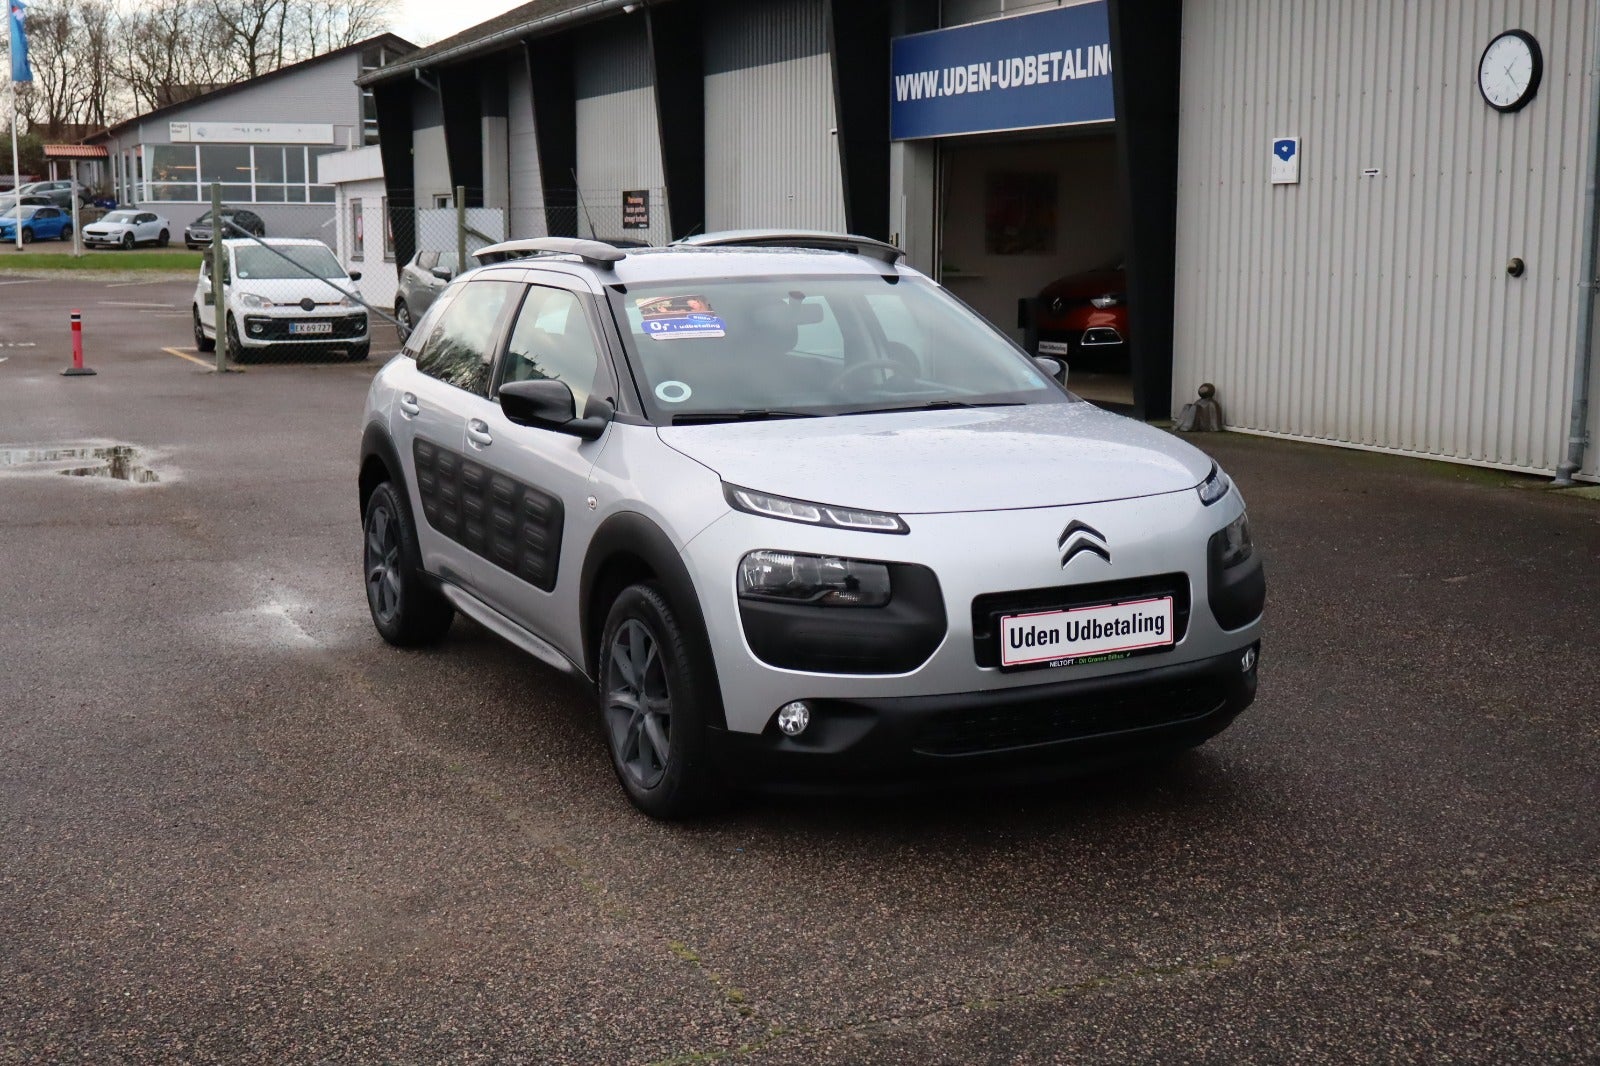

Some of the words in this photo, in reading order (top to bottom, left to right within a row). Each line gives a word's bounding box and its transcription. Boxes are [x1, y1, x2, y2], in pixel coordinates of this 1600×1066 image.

[1010, 625, 1060, 649] Uden
[1066, 613, 1165, 642] Udbetaling
[1049, 658, 1075, 667] NELTOFT
